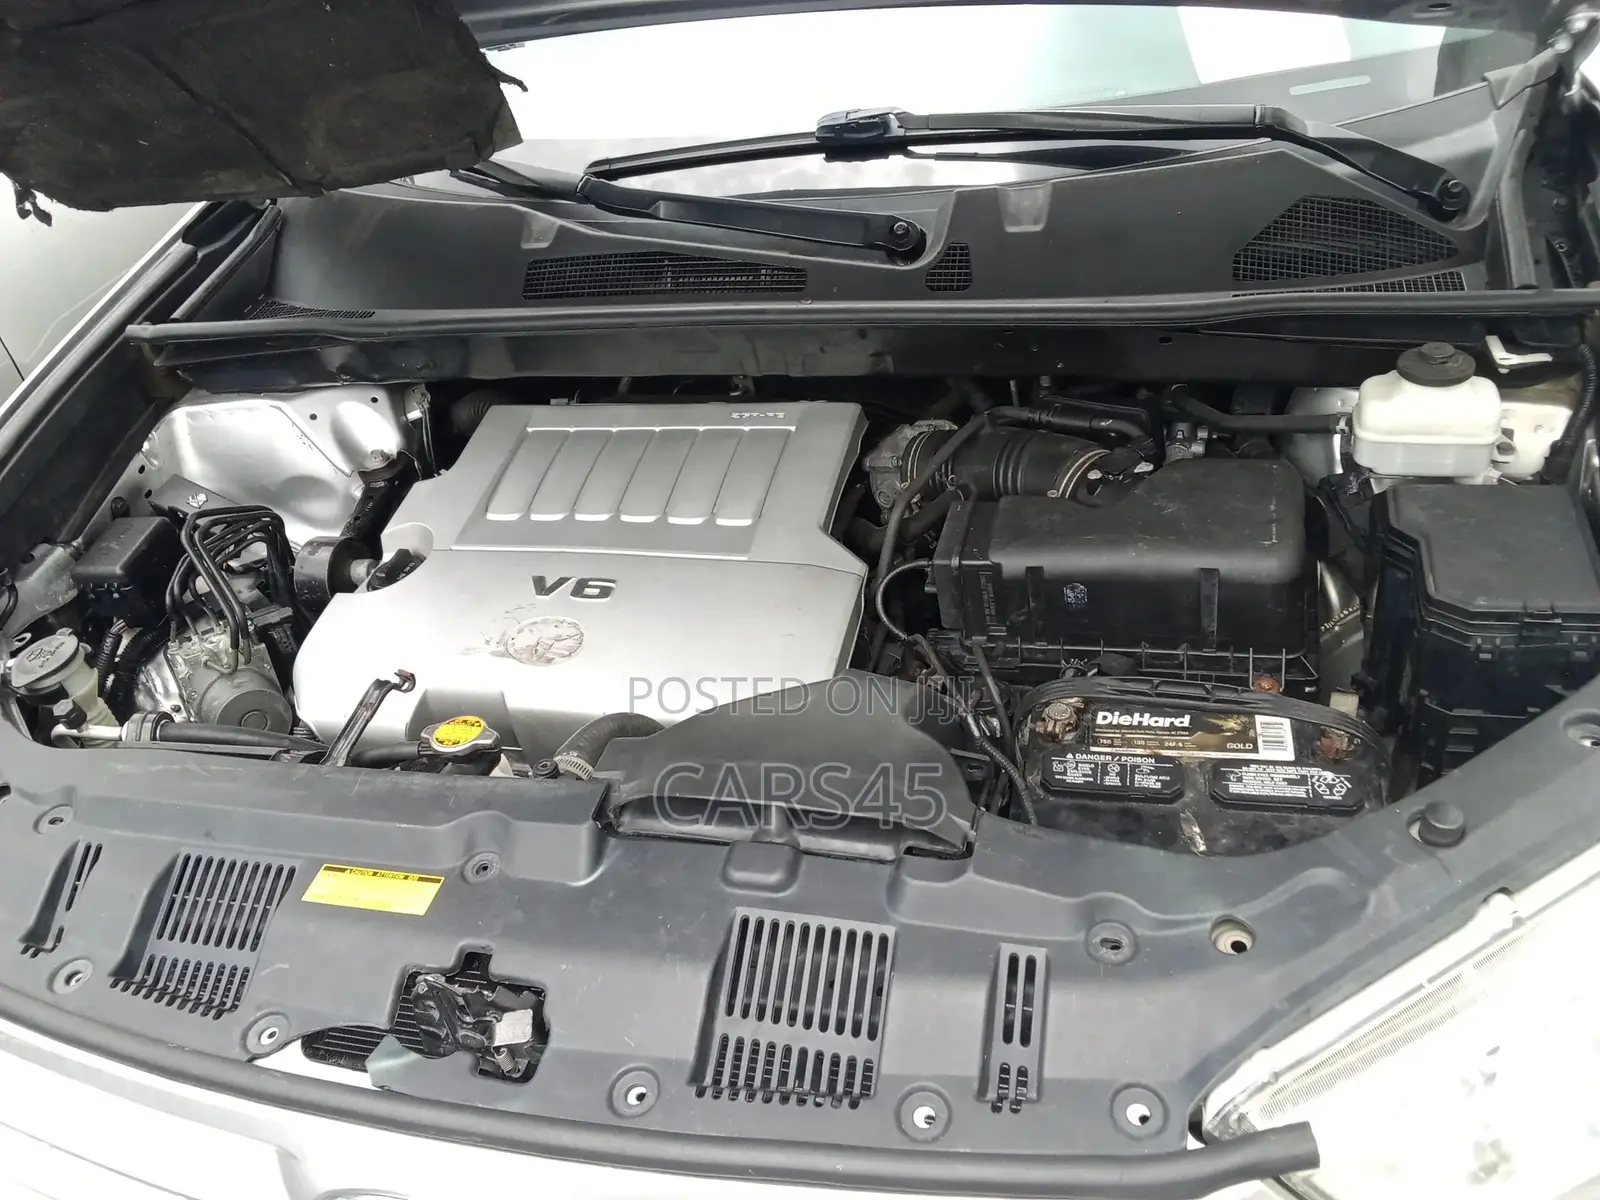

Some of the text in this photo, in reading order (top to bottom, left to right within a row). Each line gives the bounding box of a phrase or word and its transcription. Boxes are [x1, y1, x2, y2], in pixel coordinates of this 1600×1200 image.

[531, 575, 617, 602] V6
[1095, 711, 1191, 728] DieHard
[1226, 742, 1254, 751] GOLD
[1075, 753, 1112, 762] DANGER
[1121, 755, 1155, 764] POISON
